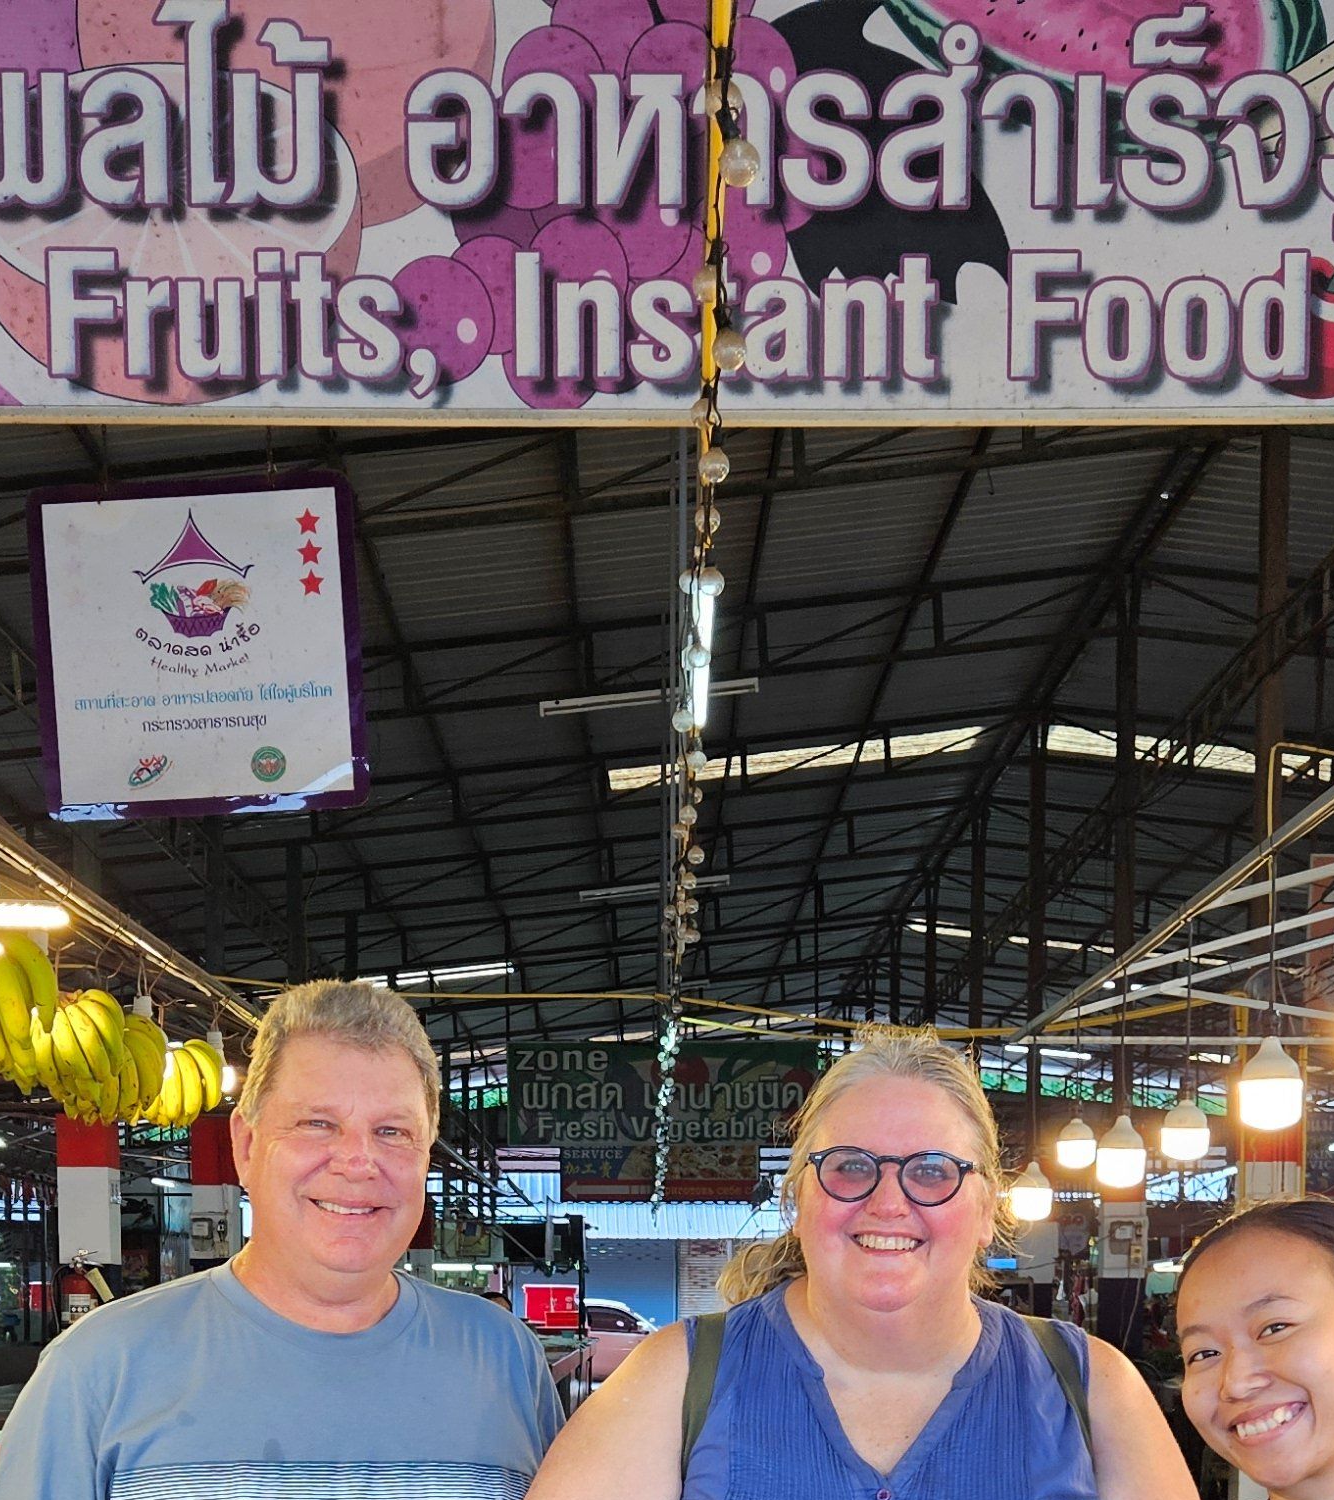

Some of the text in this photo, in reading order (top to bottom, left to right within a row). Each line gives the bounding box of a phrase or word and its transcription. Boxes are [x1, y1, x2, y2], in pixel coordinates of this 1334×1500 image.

[44, 247, 436, 397] Fruits,
[1008, 247, 1312, 384] Food
[134, 622, 261, 657] ตลาดสด น่าซื้อ
[151, 653, 250, 678] Healthy Market
[162, 686, 253, 707] อาหารปลอดภัย
[142, 713, 267, 733] กระทรวงสาธารณสุข
[516, 1050, 609, 1071] zone
[538, 1115, 617, 1139] Fresh
[563, 1150, 624, 1160] SERVICE
